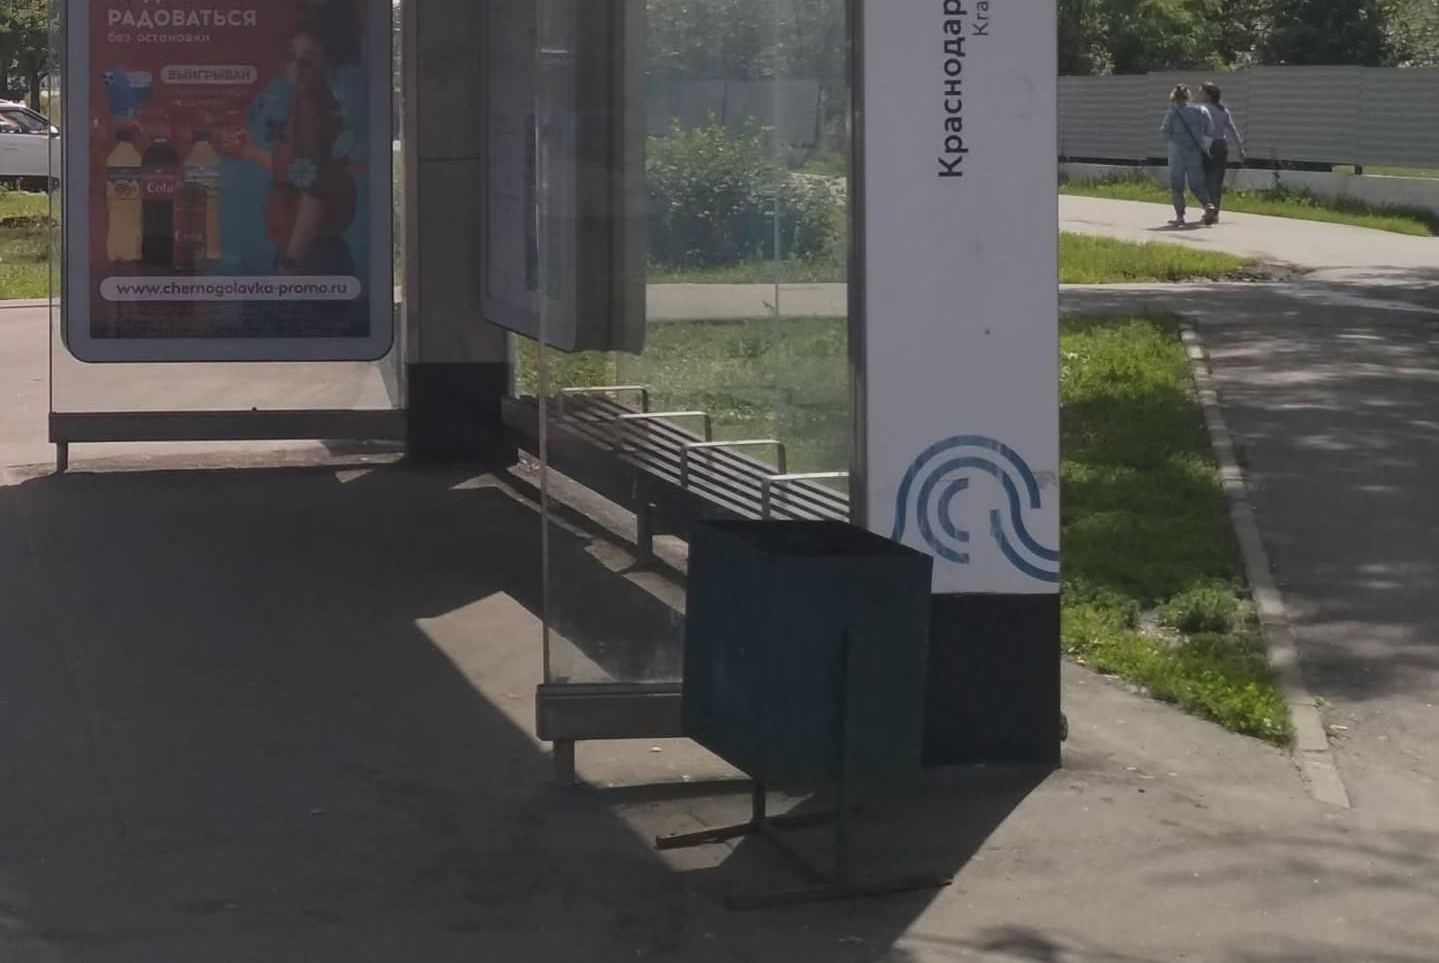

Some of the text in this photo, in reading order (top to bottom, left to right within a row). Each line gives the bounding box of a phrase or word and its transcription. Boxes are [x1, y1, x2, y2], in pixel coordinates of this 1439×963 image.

[107, 9, 257, 29] РАДОВАТЬСЯ
[167, 67, 251, 81] ВЫИГРЫВАЙ
[116, 281, 347, 297] www.chernogolovka-promo.ru
